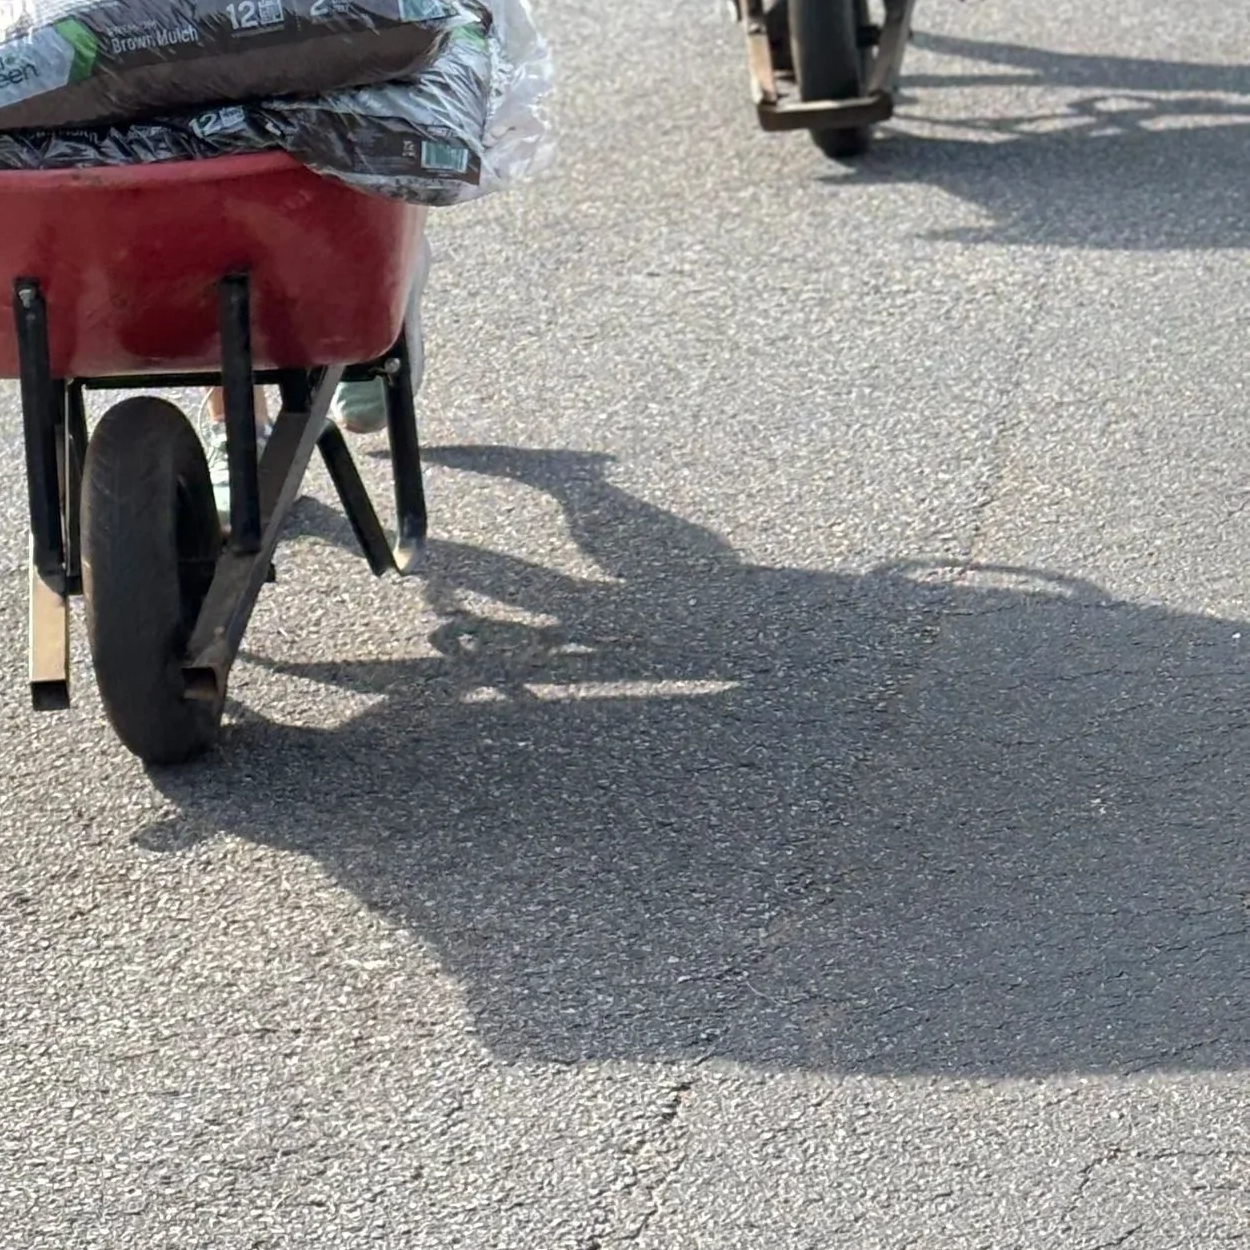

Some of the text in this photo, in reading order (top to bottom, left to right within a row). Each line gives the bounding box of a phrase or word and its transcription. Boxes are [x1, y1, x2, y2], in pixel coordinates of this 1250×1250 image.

[226, 0, 259, 30] 12
[111, 34, 156, 54] Brown
[156, 26, 199, 47] Mulch
